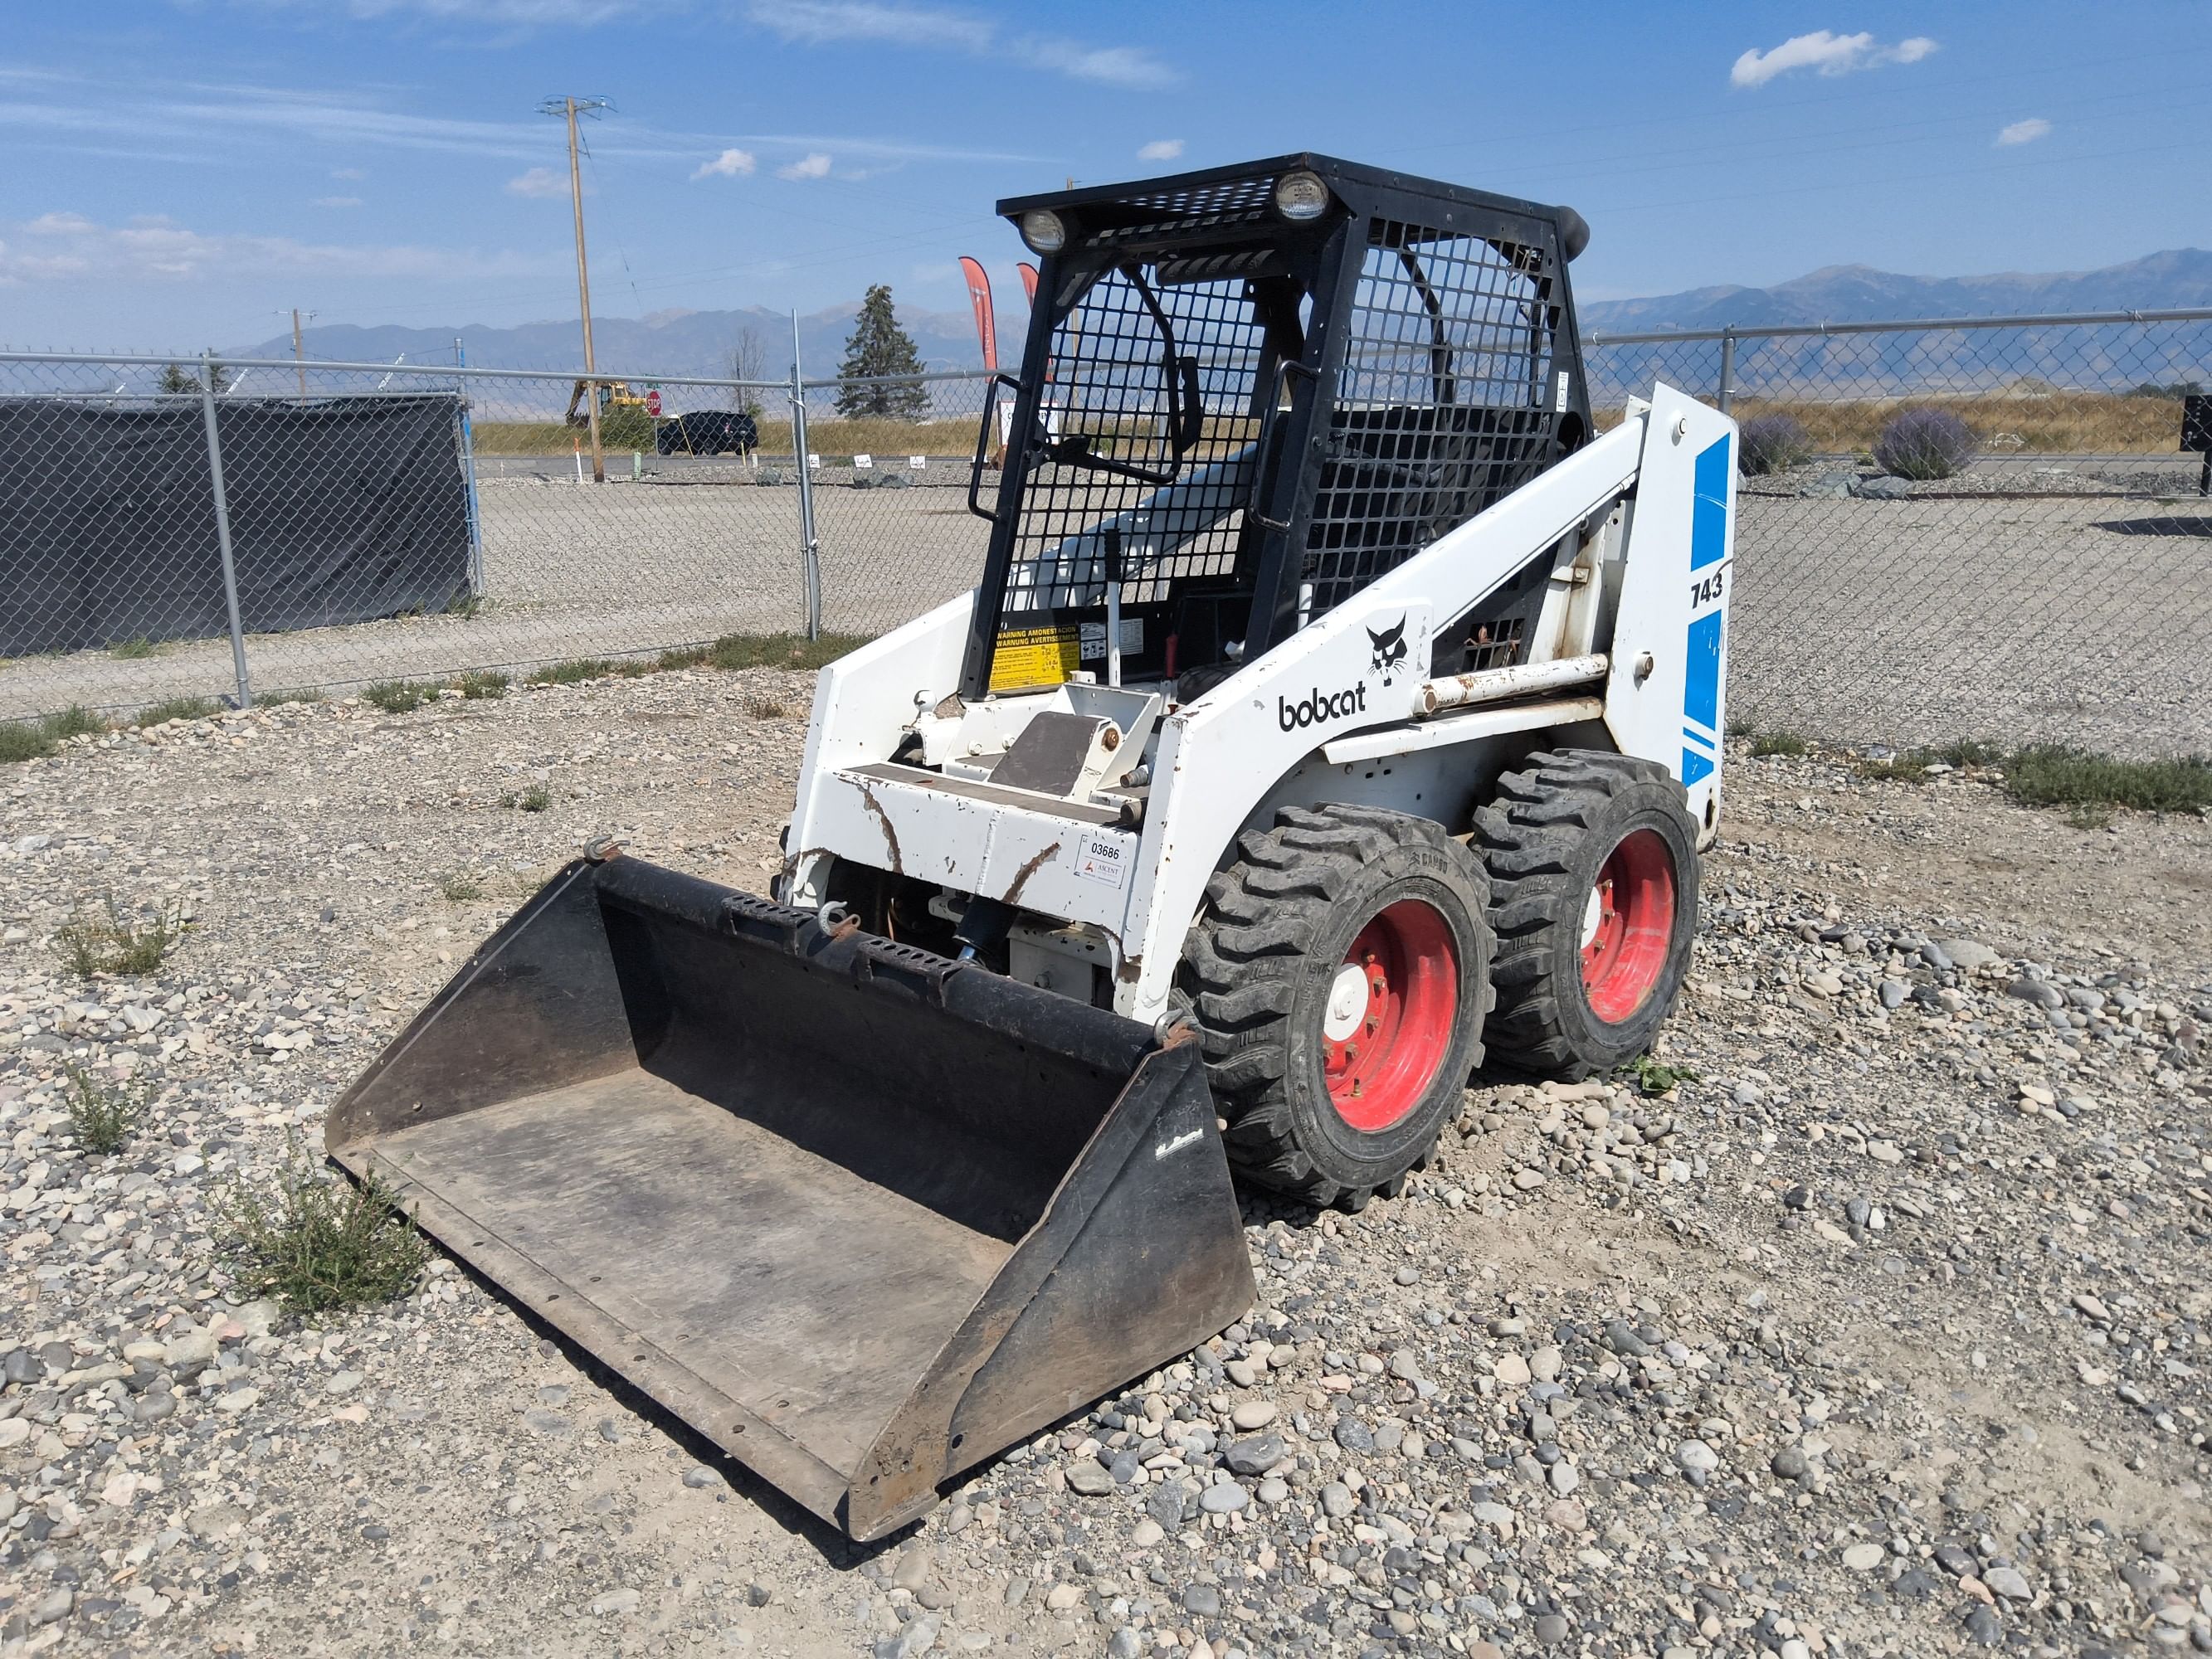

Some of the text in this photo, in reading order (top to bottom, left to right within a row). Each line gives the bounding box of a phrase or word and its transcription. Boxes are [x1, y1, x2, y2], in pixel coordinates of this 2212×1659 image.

[647, 398, 661, 409] STOP
[1691, 572, 1723, 610] 743
[997, 630, 1026, 640] WARNING
[996, 638, 1029, 647] WARNUNG
[1279, 680, 1366, 732] bobcat
[1091, 842, 1120, 859] 03686
[1097, 864, 1118, 875] ASCENT
